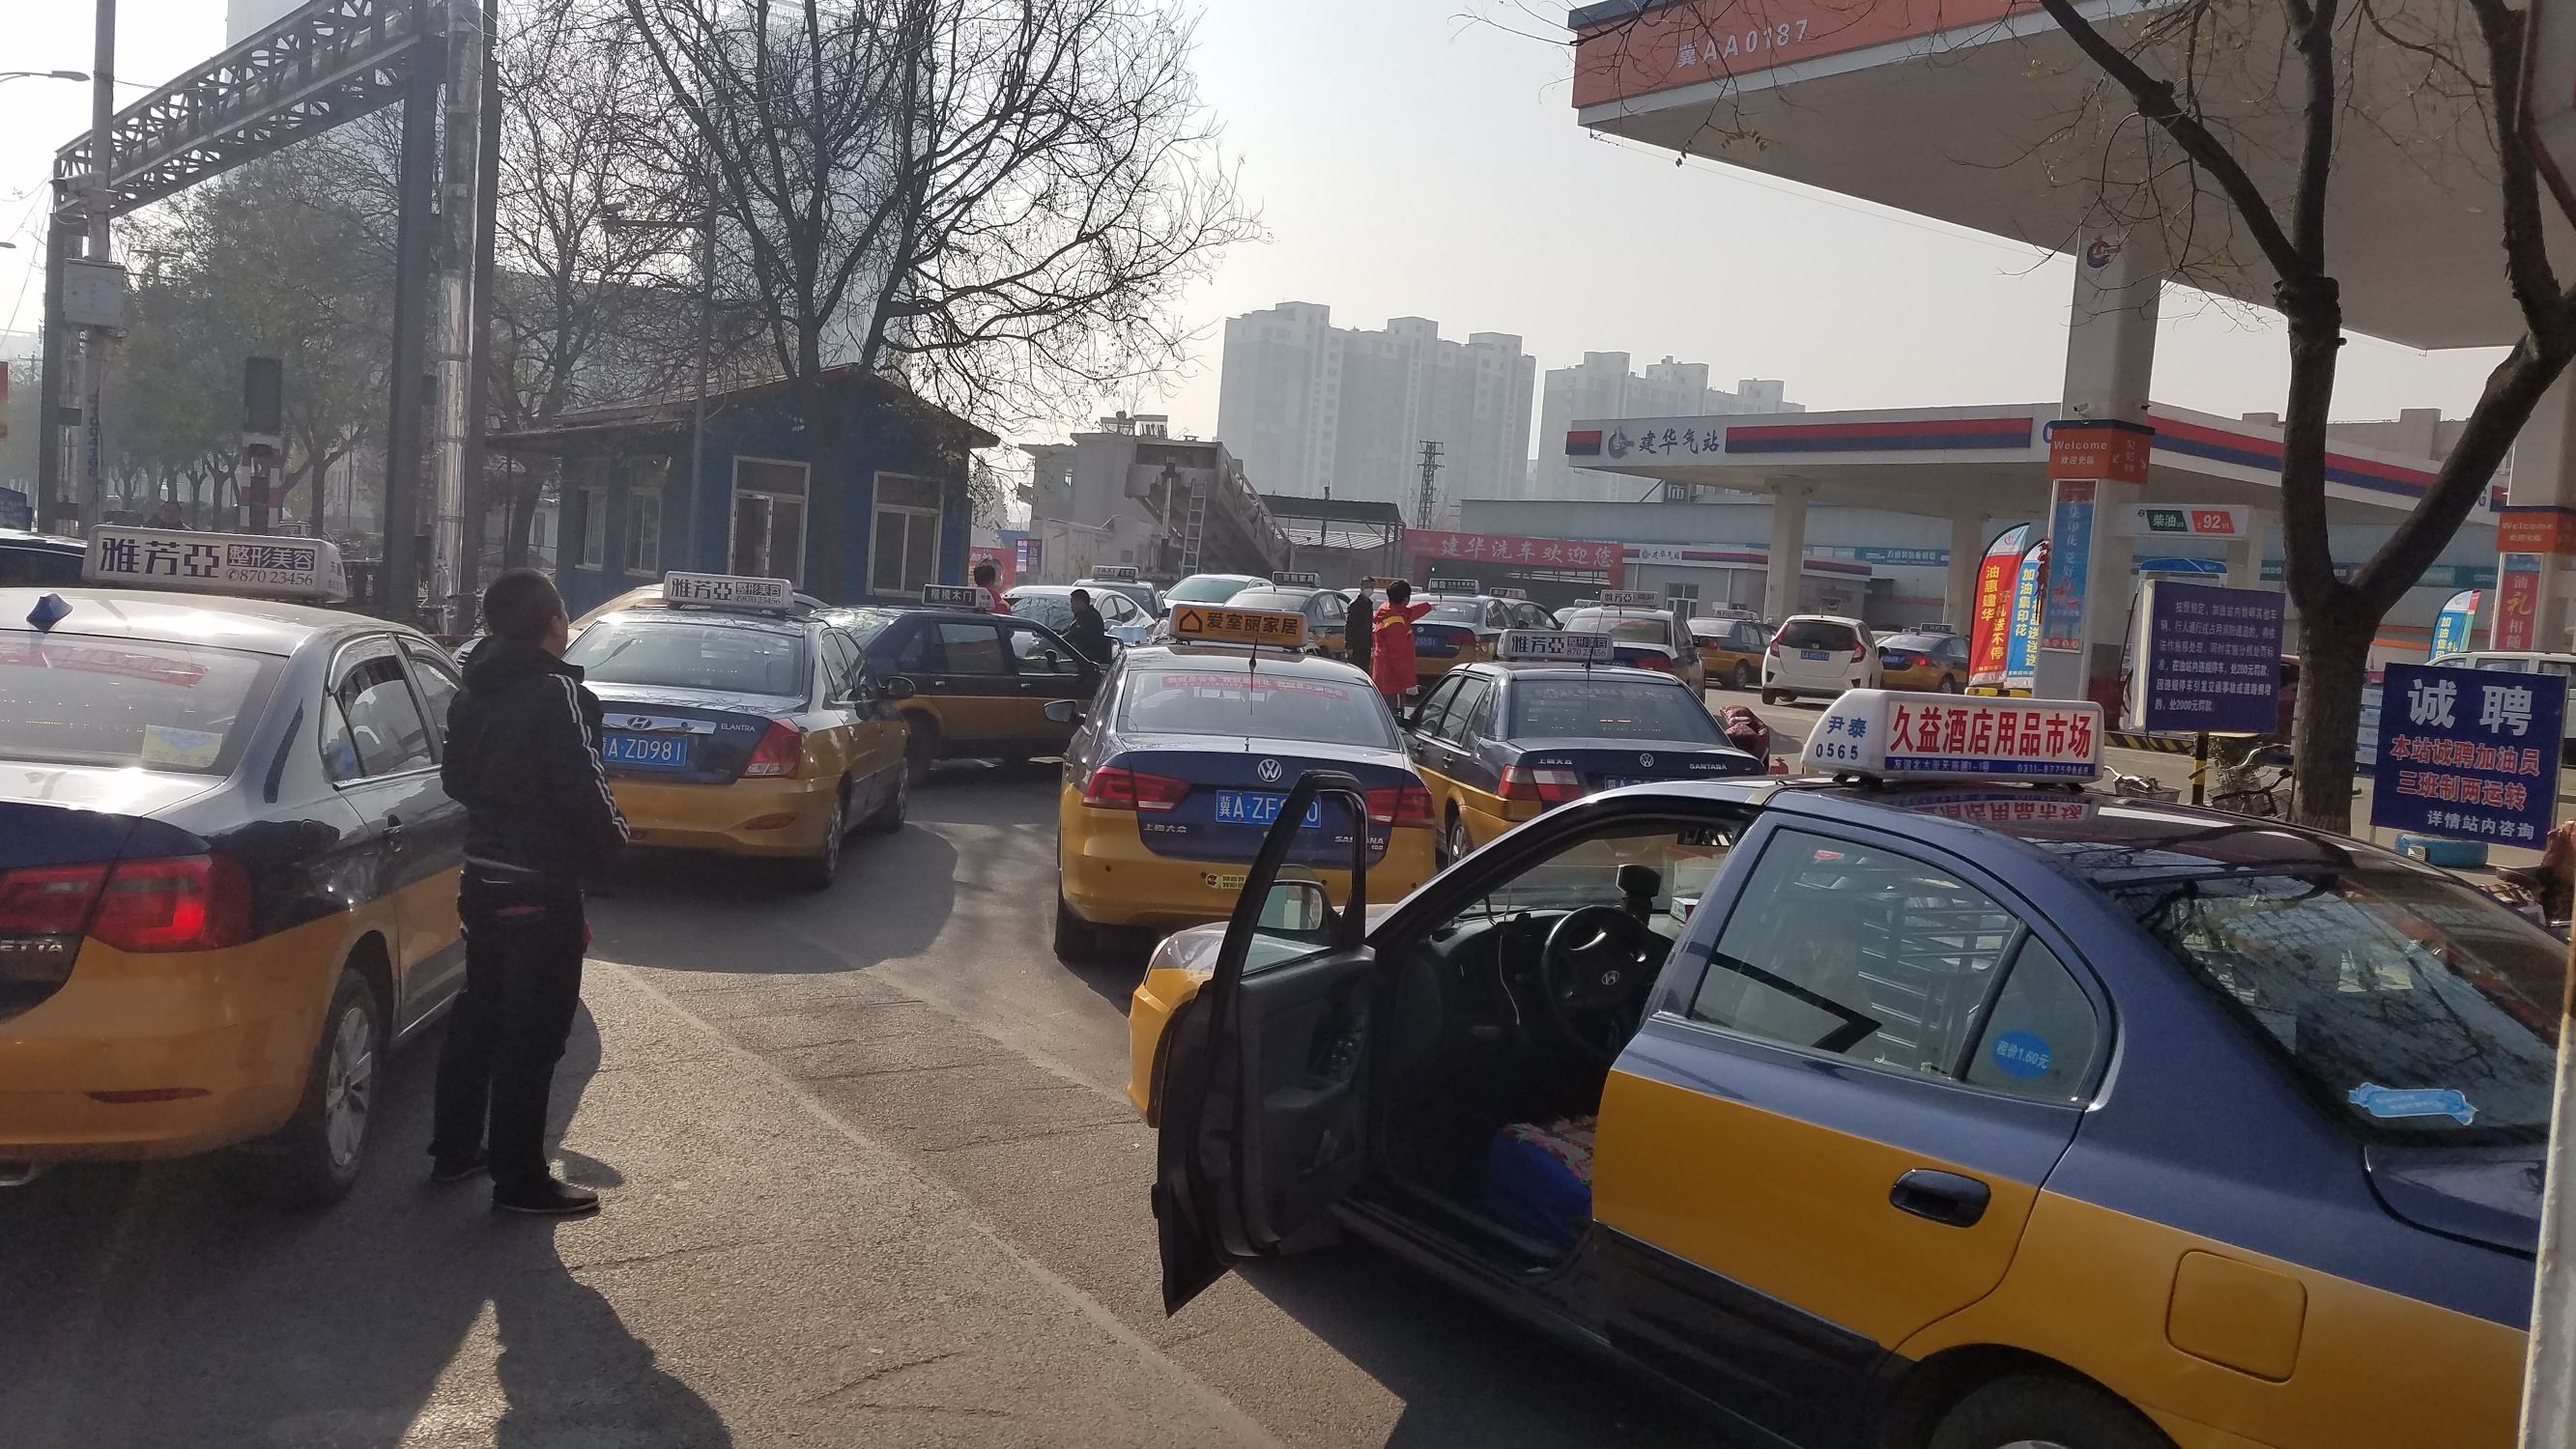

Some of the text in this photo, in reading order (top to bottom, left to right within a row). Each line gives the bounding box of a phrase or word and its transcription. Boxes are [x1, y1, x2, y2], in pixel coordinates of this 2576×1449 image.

[1676, 19, 1811, 69] 冀AA0187
[1638, 428, 1720, 455] 建华气站
[2054, 440, 2107, 450] Welcome
[2153, 514, 2177, 527] 柴油
[2203, 514, 2221, 529] 92
[228, 545, 315, 571] 整形美容
[1441, 534, 1615, 567] 建华洗车欢迎您
[242, 569, 267, 582] 870
[270, 572, 313, 586] 23456
[1207, 611, 1299, 636] 爱室丽家居
[2407, 678, 2533, 736] 诚聘
[721, 723, 756, 733] ELANTRA
[1827, 715, 1867, 739] 尹泰
[1890, 704, 2093, 758] 久益酒店用品市场
[1816, 742, 1859, 761] 0565
[2390, 733, 2541, 777] 本站诚聘加油员
[1689, 762, 1728, 771] SANTANA
[2396, 771, 2528, 811] 三班制两运转
[2426, 810, 2535, 841] 详情站内咨询
[1334, 836, 1385, 845] SANA
[0, 938, 63, 952] ETTA
